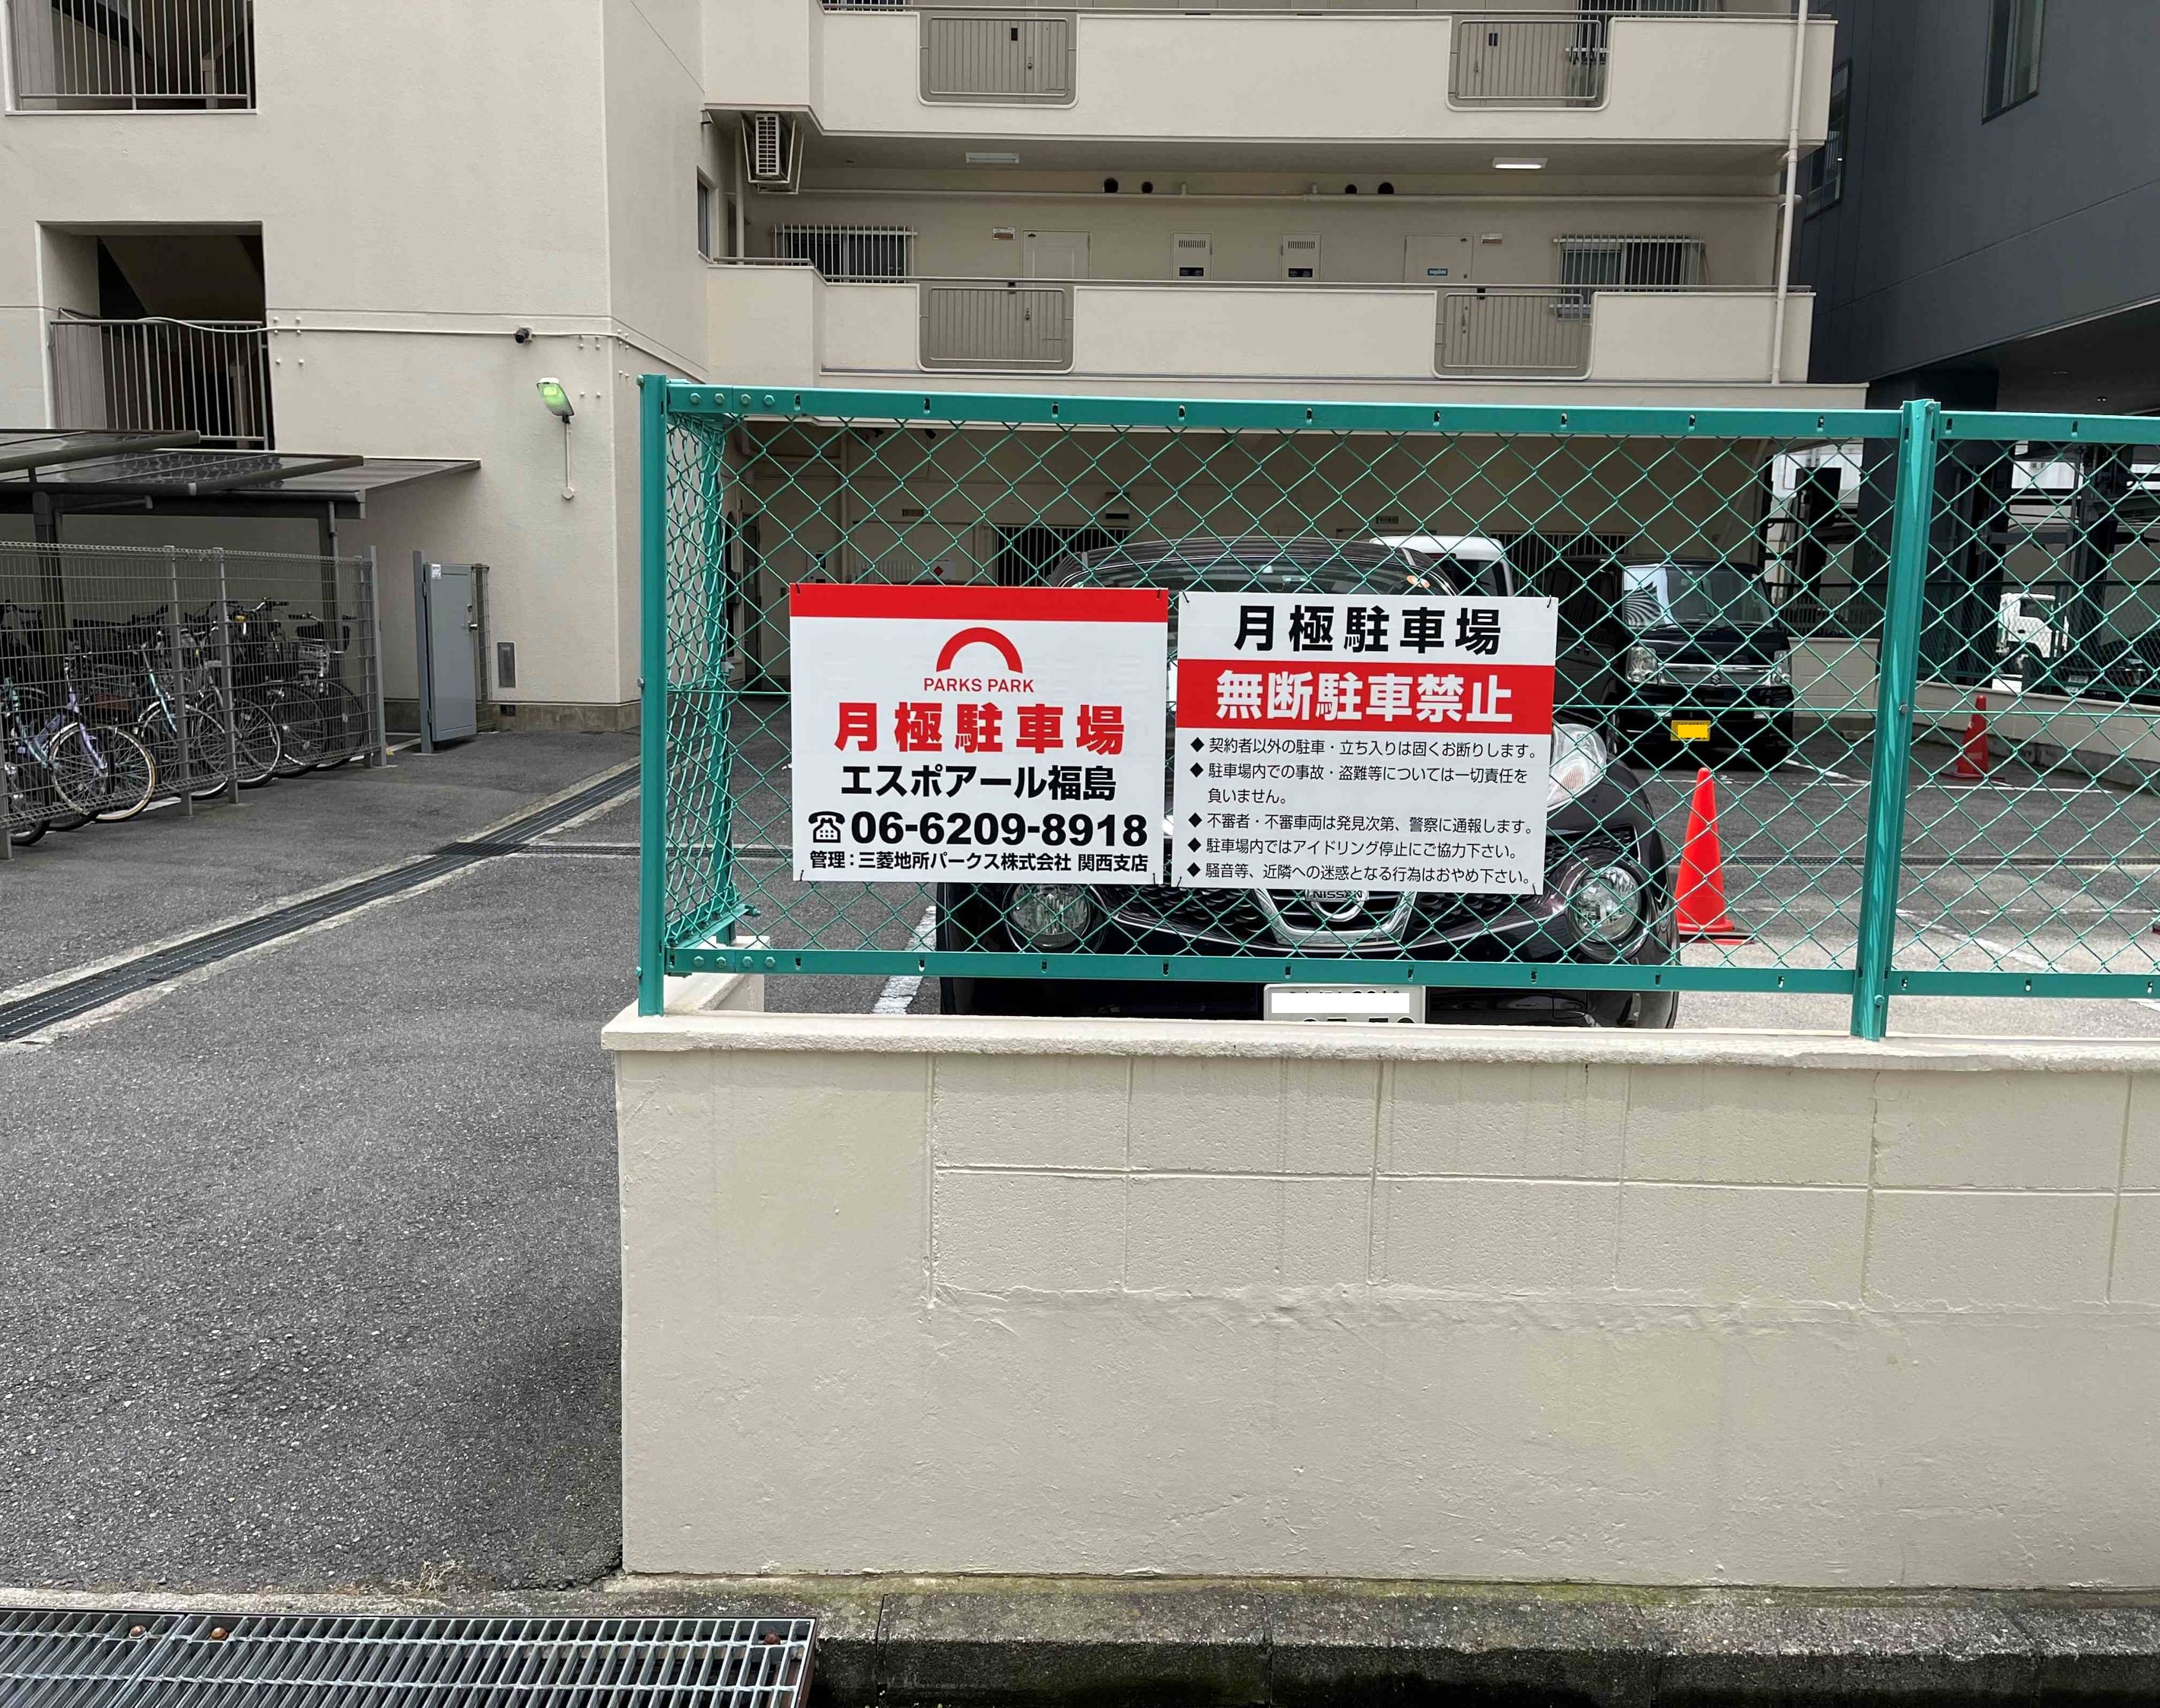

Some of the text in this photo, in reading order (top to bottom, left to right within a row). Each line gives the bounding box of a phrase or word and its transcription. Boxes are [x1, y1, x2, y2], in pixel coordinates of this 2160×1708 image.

[1234, 605, 1501, 656] 月極駐車場
[924, 678, 1034, 693] PARKS PARK
[1215, 669, 1513, 722] 無断駐車禁止
[834, 701, 1125, 756] 月極駐車場
[1209, 737, 1536, 759] 契約者以外の駐車・立ち入りは固くお断りします。
[840, 763, 1117, 801] エスポアール福島
[1208, 762, 1528, 784] 駐車場内での事故・盗難等については一切責任を
[1208, 787, 1286, 805] 負いません。
[851, 811, 1148, 847] 06-6209-8918
[1207, 812, 1532, 834] 不審者・不審車両は発見次第、警察に通報します。
[1205, 837, 1516, 859] 駐車場内ではアイドリング停止にご協力下さい。
[1078, 853, 1148, 872] 関西支店
[1205, 862, 1529, 884] 騒音等、近隣への迷惑となる行為はおやめ下さい。
